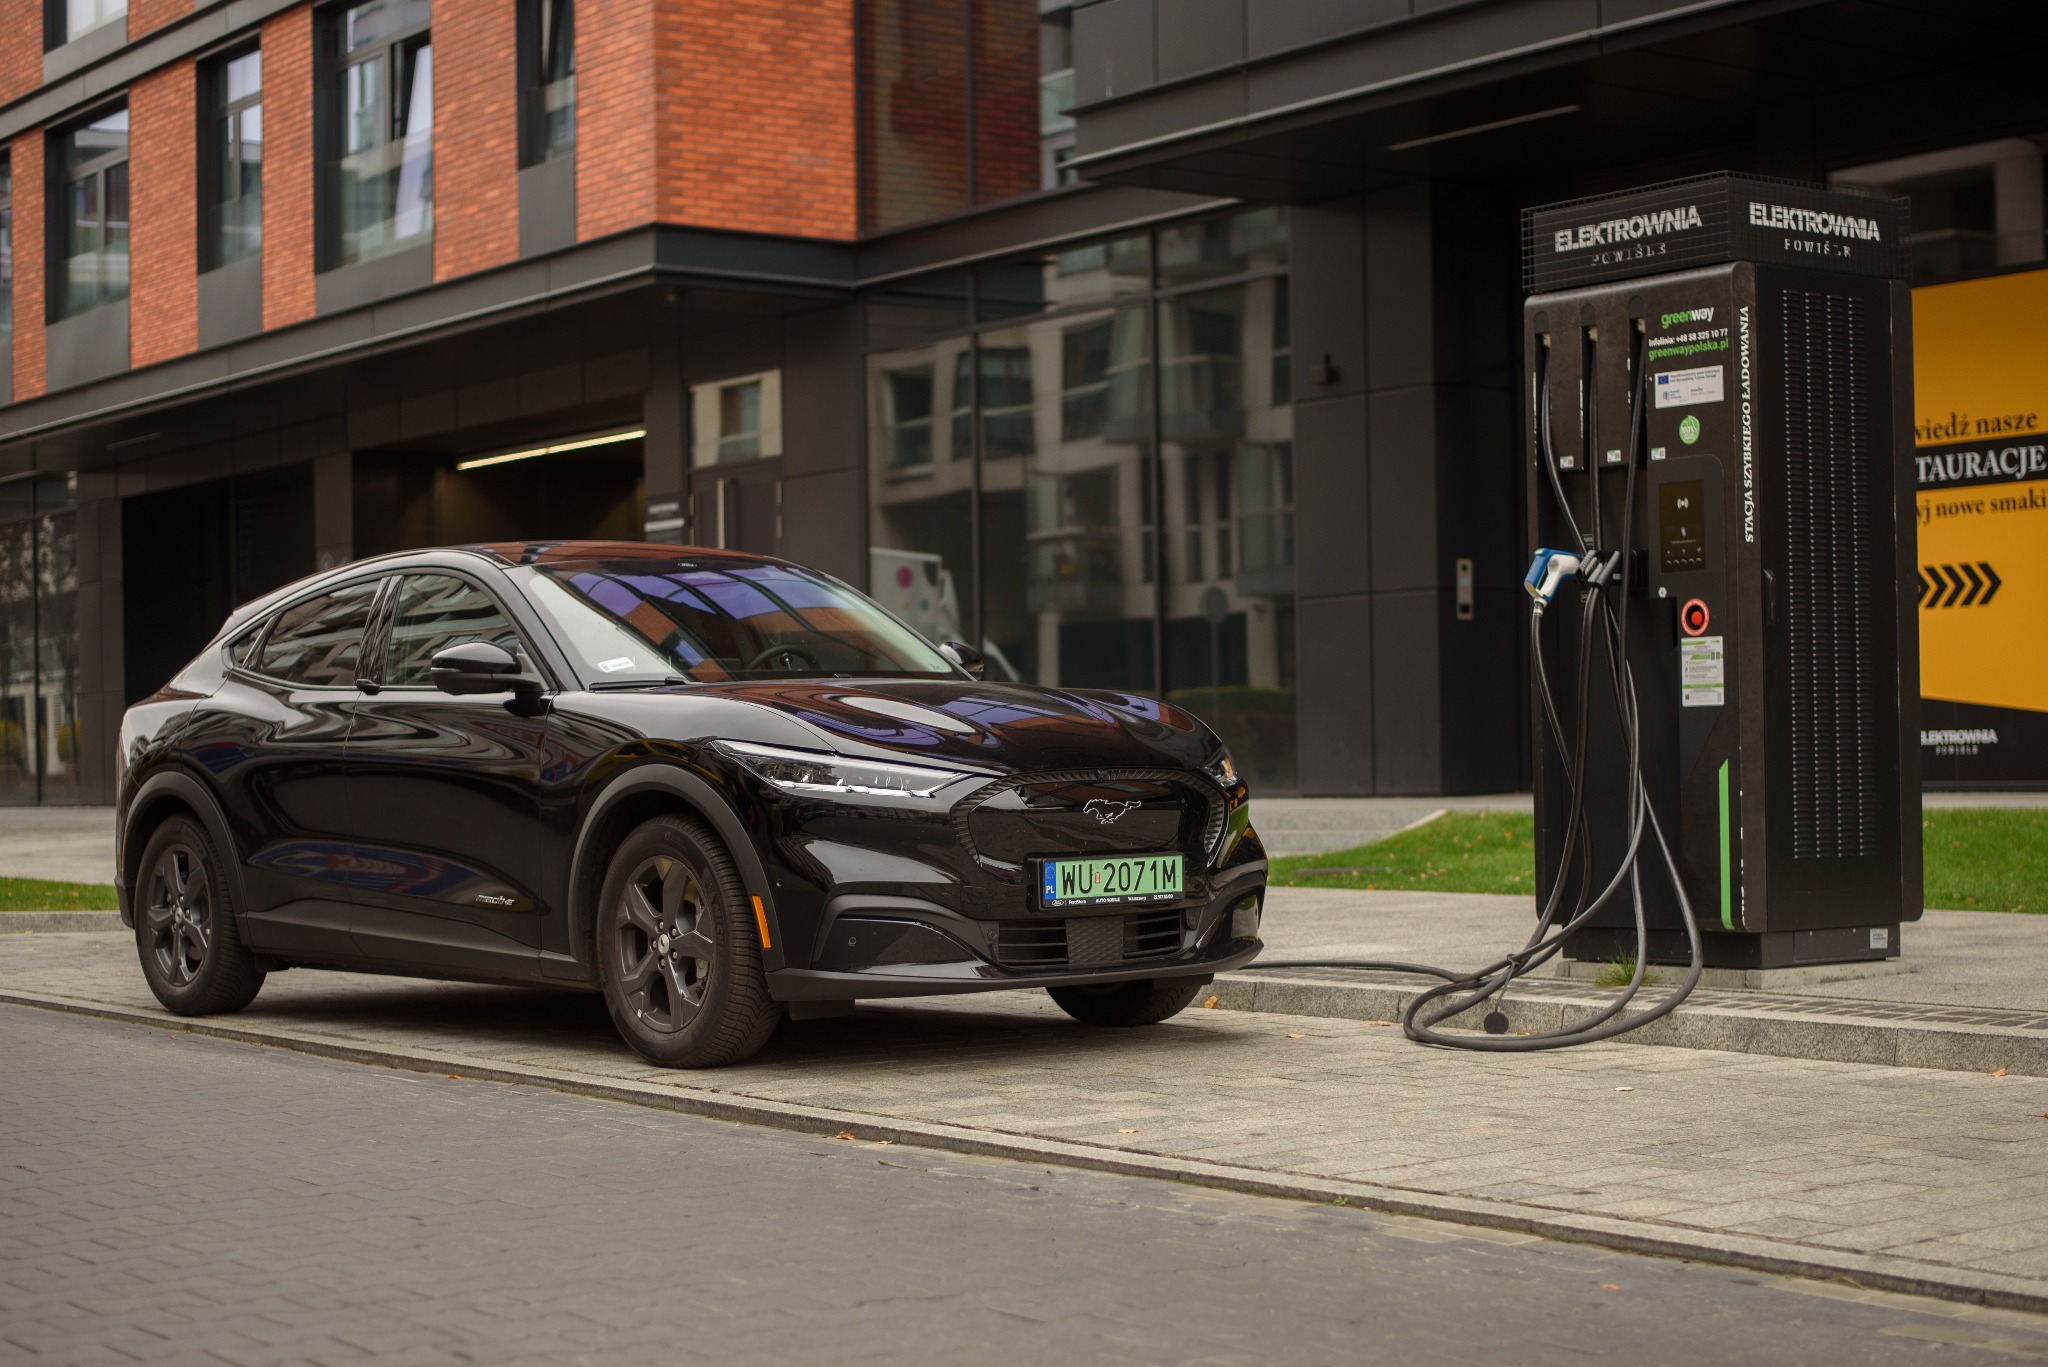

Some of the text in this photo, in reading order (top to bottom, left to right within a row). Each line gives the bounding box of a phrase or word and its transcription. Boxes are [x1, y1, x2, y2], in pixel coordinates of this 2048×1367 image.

[1554, 205, 1703, 253] ELEKTROWNIA
[1748, 202, 1881, 242] ELEKTROWNIA
[1661, 306, 1715, 330] greenway
[1711, 329, 1720, 339] 10
[1720, 327, 1729, 337] 77
[1648, 336, 1729, 362] greenwaypolska.pl
[1740, 306, 1755, 543] STACJA SZYBKIEGO ŁADOWANIA
[1976, 411, 2038, 435] nasze
[1914, 445, 2048, 484] TAURACJE
[1936, 499, 1986, 519] nowe
[1045, 885, 1055, 894] PL
[1062, 858, 1177, 896] WU 2071M
